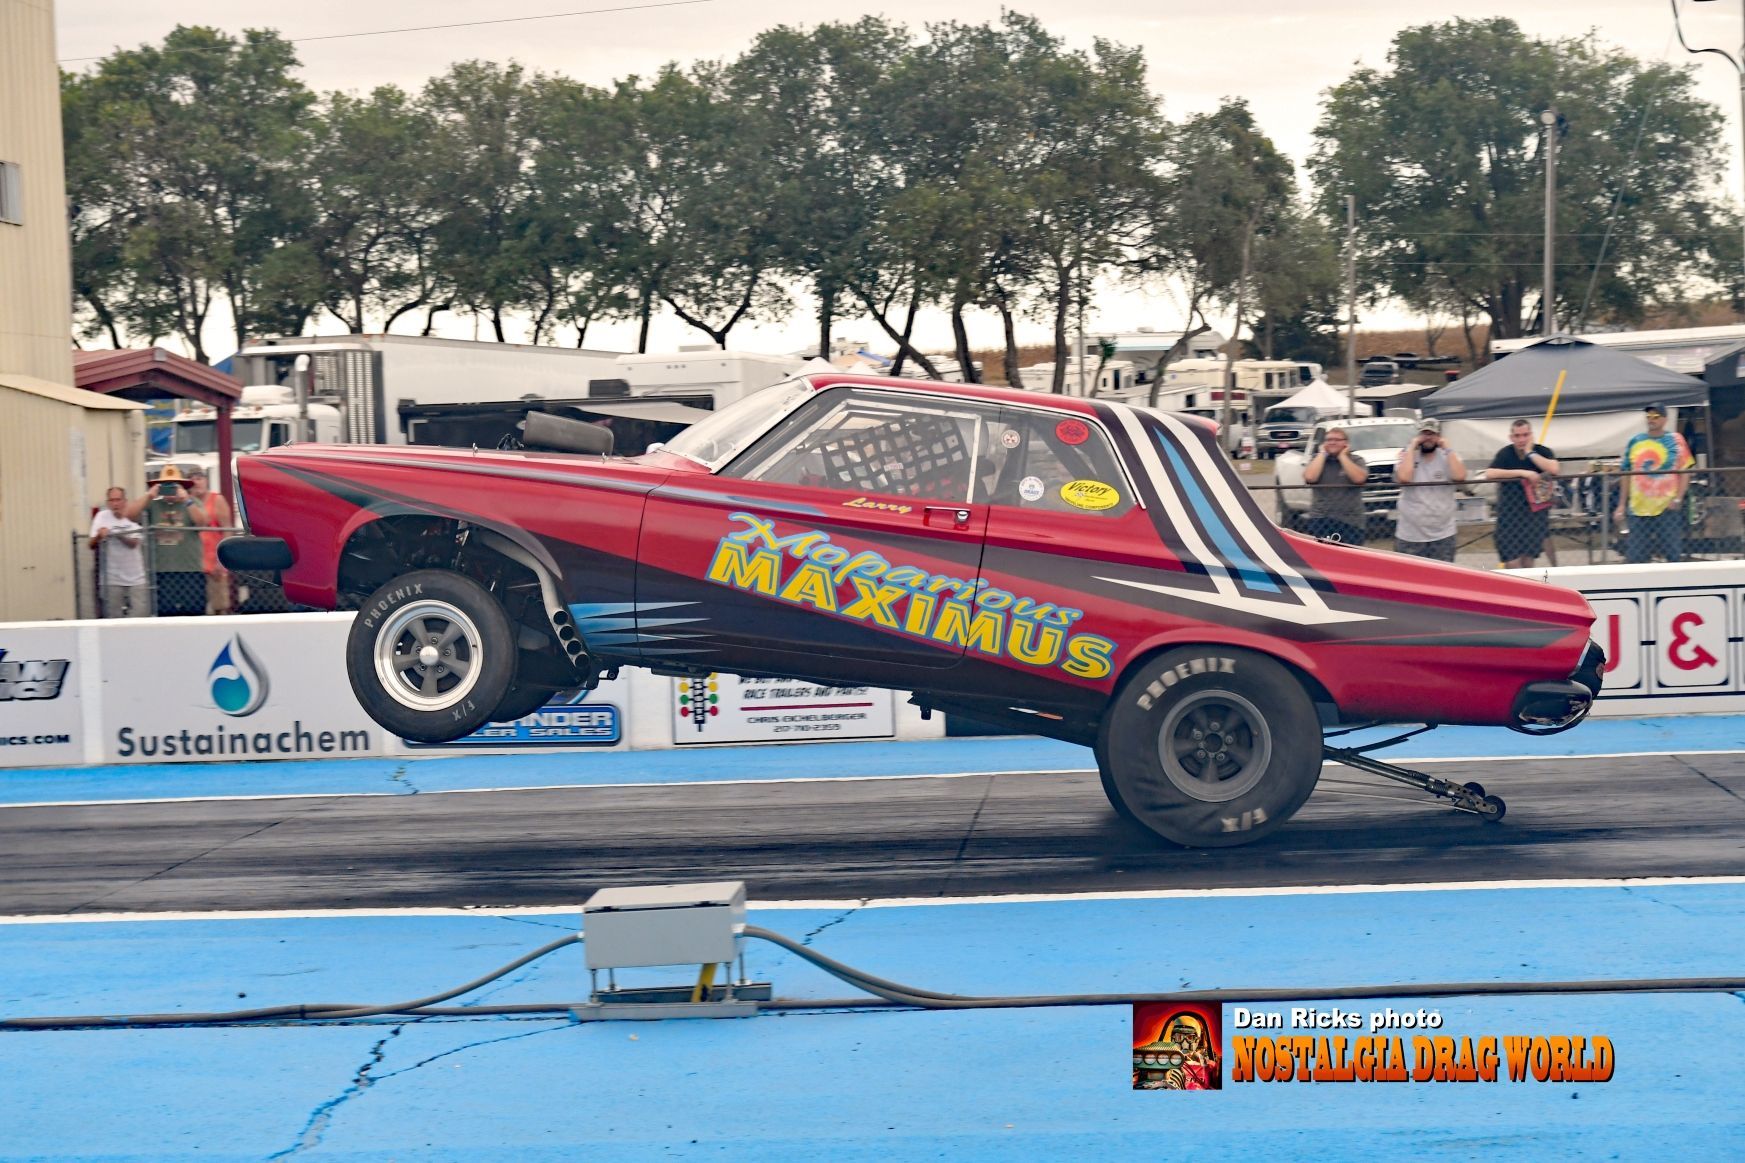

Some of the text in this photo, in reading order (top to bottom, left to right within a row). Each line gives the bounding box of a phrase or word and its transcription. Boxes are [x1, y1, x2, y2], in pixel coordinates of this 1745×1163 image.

[842, 497, 912, 514] Larry
[1067, 481, 1112, 496] Victory
[728, 512, 1083, 629] Moparious
[364, 583, 423, 628] PHOENIX
[705, 539, 1119, 680] MAXIMUS
[1668, 611, 1718, 671] &
[744, 688, 767, 699] RACE
[769, 686, 812, 698] TRAILERS
[1136, 657, 1237, 711] PHOENIX
[118, 720, 370, 757] Sustainachem
[528, 727, 614, 737] SALES
